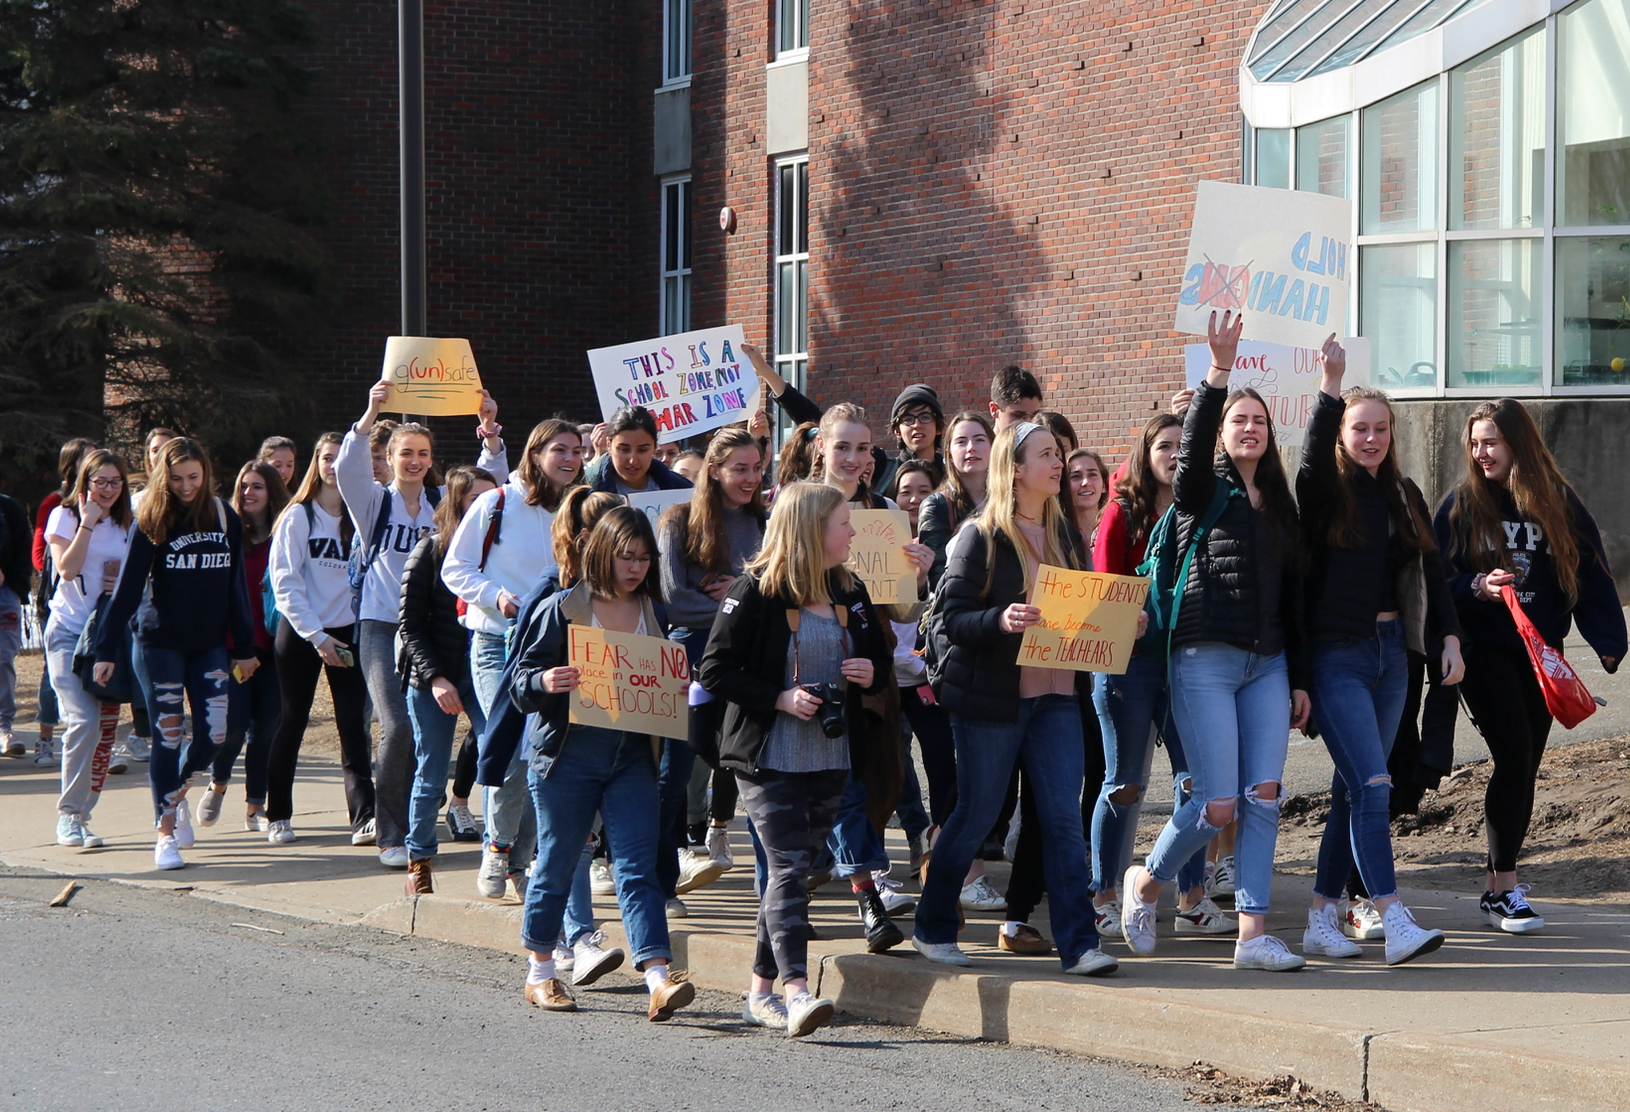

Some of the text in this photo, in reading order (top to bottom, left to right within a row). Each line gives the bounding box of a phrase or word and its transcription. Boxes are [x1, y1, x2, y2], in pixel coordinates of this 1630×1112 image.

[623, 340, 735, 380] THIS IS A
[1235, 353, 1271, 373] ave
[614, 381, 669, 406] SCHOOL
[648, 387, 747, 432] WAR ZONE
[169, 531, 226, 551] UNIVERSITY
[166, 553, 198, 569] SAN
[1039, 571, 1148, 606] the STUDENTS
[1064, 613, 1102, 633] become
[571, 628, 689, 680] FEAR HAS NO
[1023, 634, 1052, 661] the
[612, 672, 623, 681] in
[629, 674, 662, 689] OUR
[579, 680, 677, 719] SCHOOLS!
